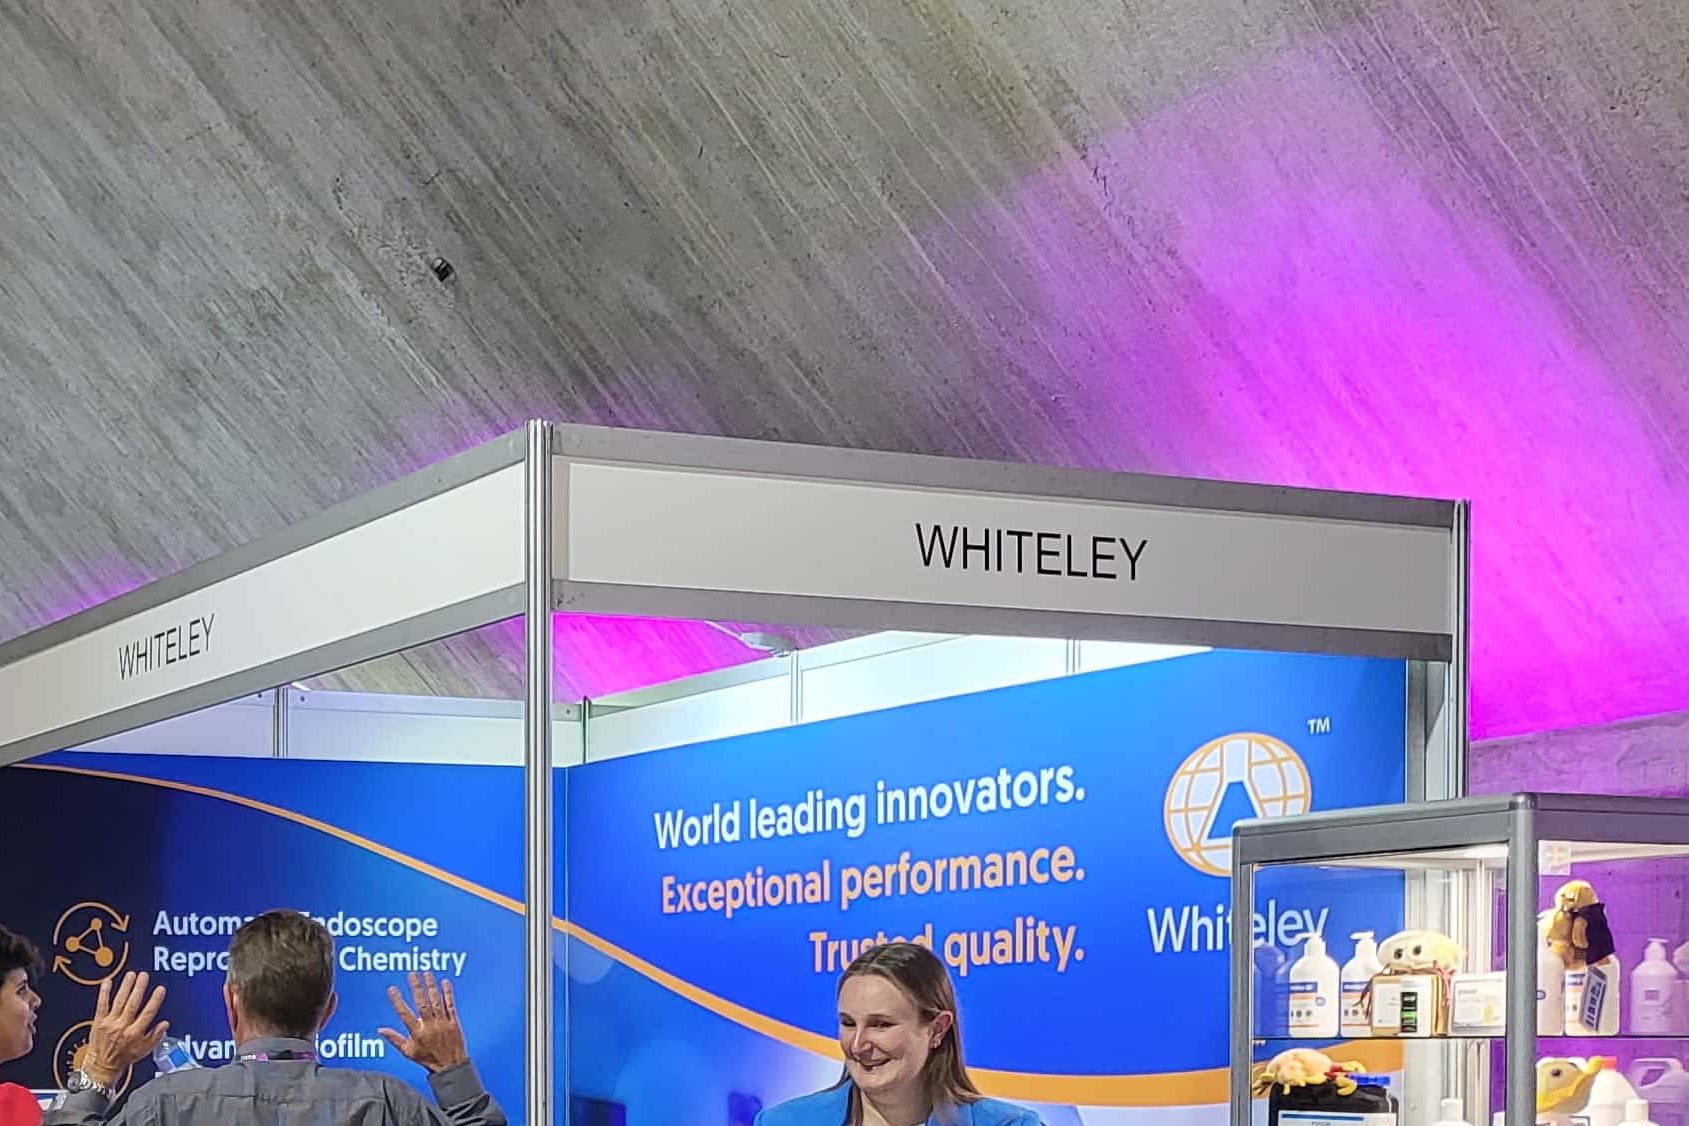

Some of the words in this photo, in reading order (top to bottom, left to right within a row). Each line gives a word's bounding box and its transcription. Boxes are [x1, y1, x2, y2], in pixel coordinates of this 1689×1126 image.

[915, 522, 1148, 581] WHITELEY
[119, 612, 215, 680] WHITELEY
[1307, 716, 1331, 735] TM
[654, 800, 741, 849] World
[749, 790, 866, 838] leading
[876, 764, 1086, 825] innovators.
[661, 859, 830, 919] Exceptional
[840, 845, 1086, 910] performance.
[296, 911, 439, 943] doscope
[943, 916, 1086, 977] quality.
[1147, 899, 1329, 953] Whieley
[339, 946, 467, 977] Chemistry
[314, 1032, 385, 1059] iofilm
